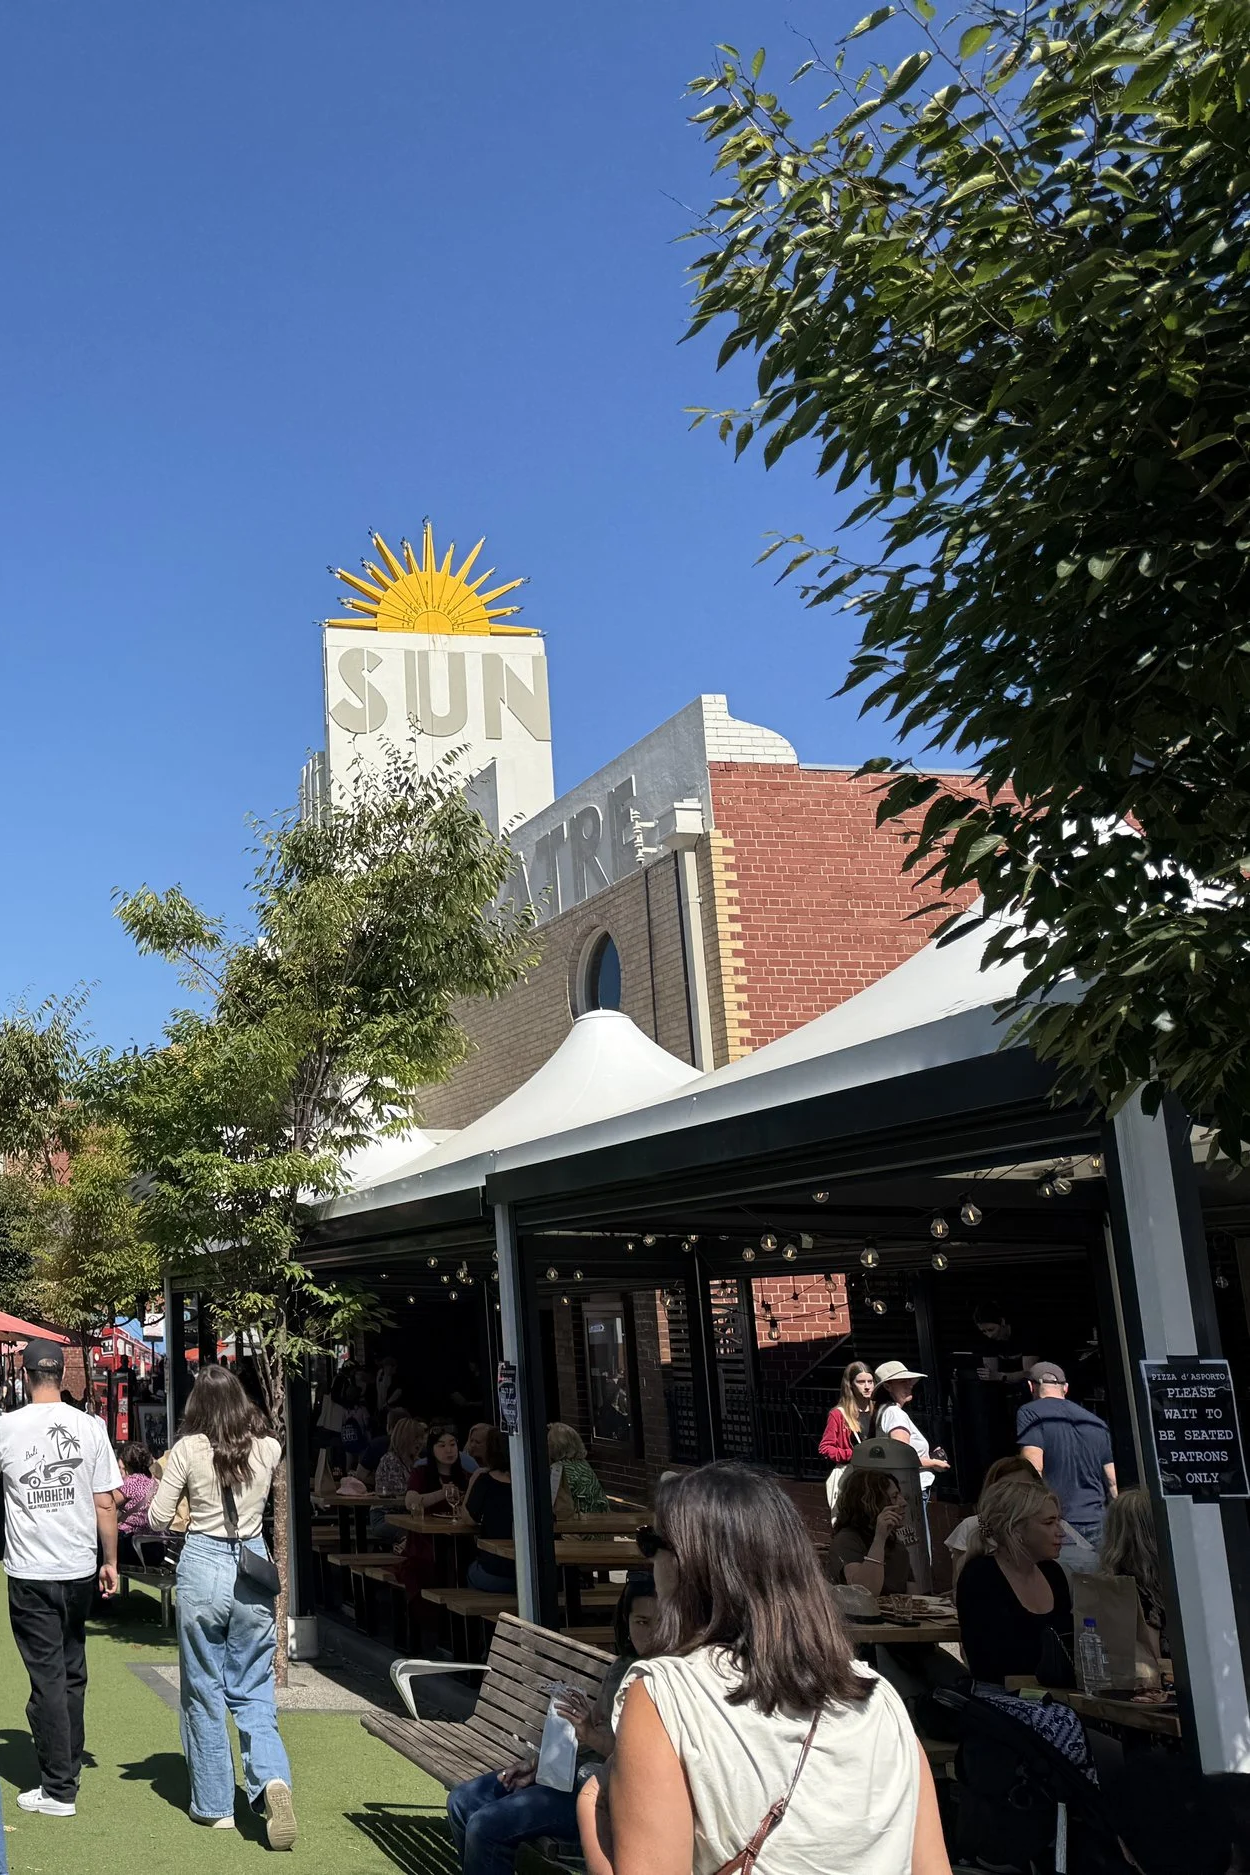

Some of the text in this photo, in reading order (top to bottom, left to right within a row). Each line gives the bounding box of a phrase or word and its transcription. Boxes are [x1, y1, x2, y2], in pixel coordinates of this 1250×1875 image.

[329, 648, 551, 741] SUN
[1152, 1373, 1177, 1381] PIZZA
[1167, 1387, 1216, 1398] PLEASE
[1164, 1408, 1223, 1419] WAIT TO
[1158, 1430, 1234, 1441] BE SEATED
[1170, 1452, 1229, 1462] PATRONS
[1185, 1473, 1219, 1483] ONLY
[27, 1487, 75, 1505] LIMBHEIM
